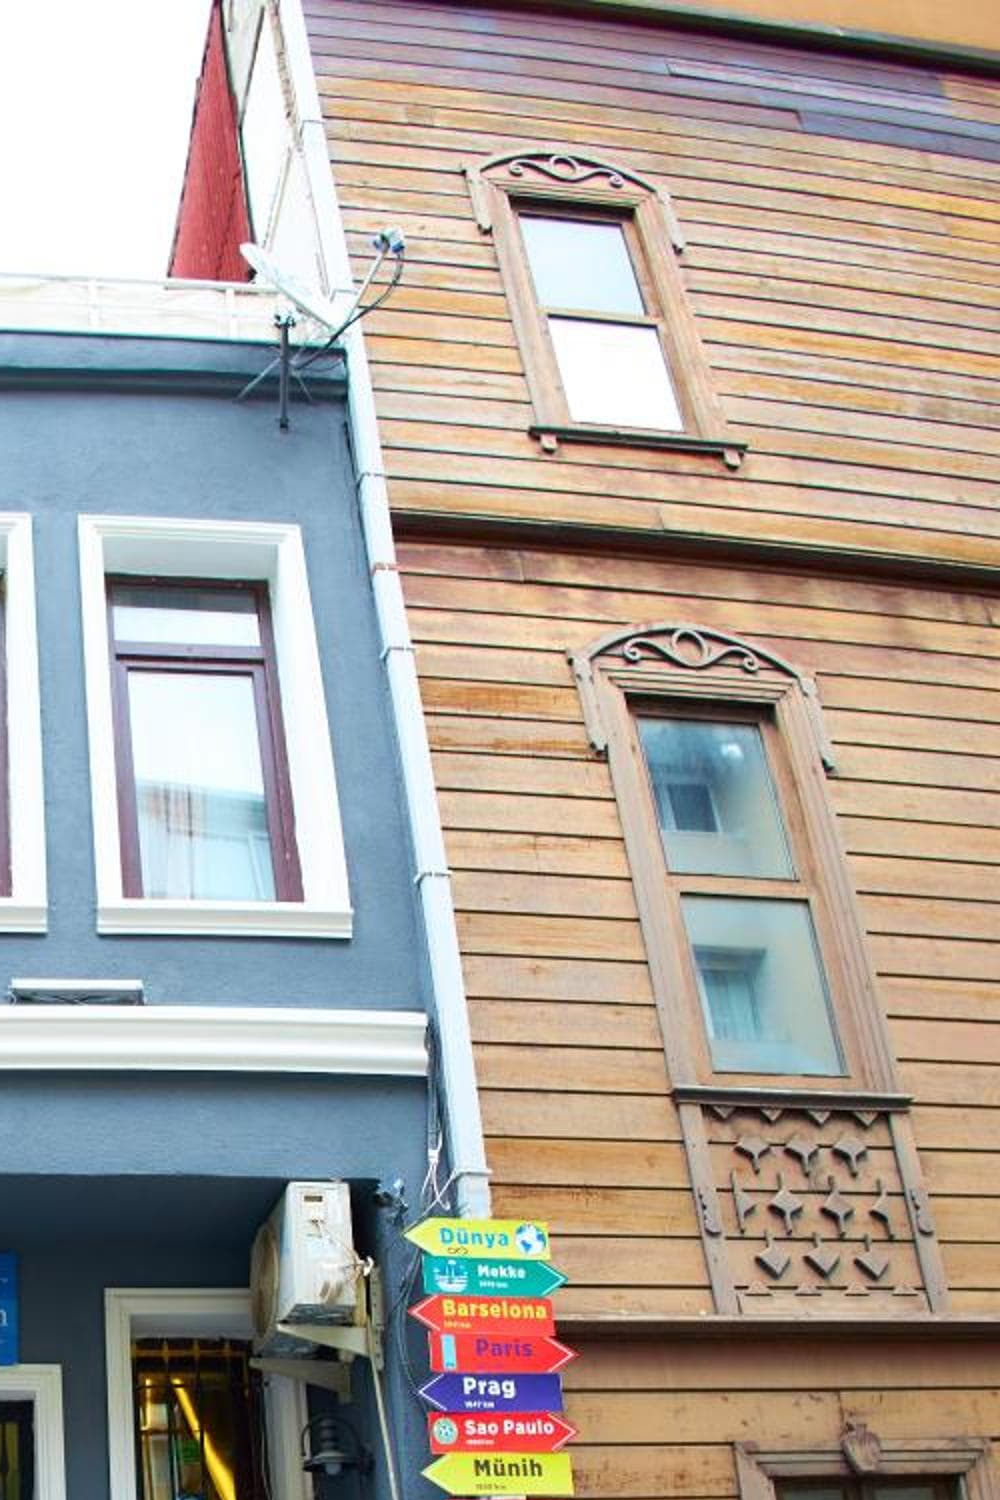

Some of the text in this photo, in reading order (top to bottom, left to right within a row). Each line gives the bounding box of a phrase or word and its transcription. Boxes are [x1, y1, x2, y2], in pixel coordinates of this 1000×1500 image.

[440, 1227, 509, 1249] Dünya
[477, 1264, 526, 1279] Mekke
[442, 1299, 547, 1319] Barselona
[475, 1338, 534, 1357] Paris
[463, 1377, 516, 1399] Prag
[464, 1419, 555, 1435] Sao Paulo
[473, 1458, 543, 1477] Münih
